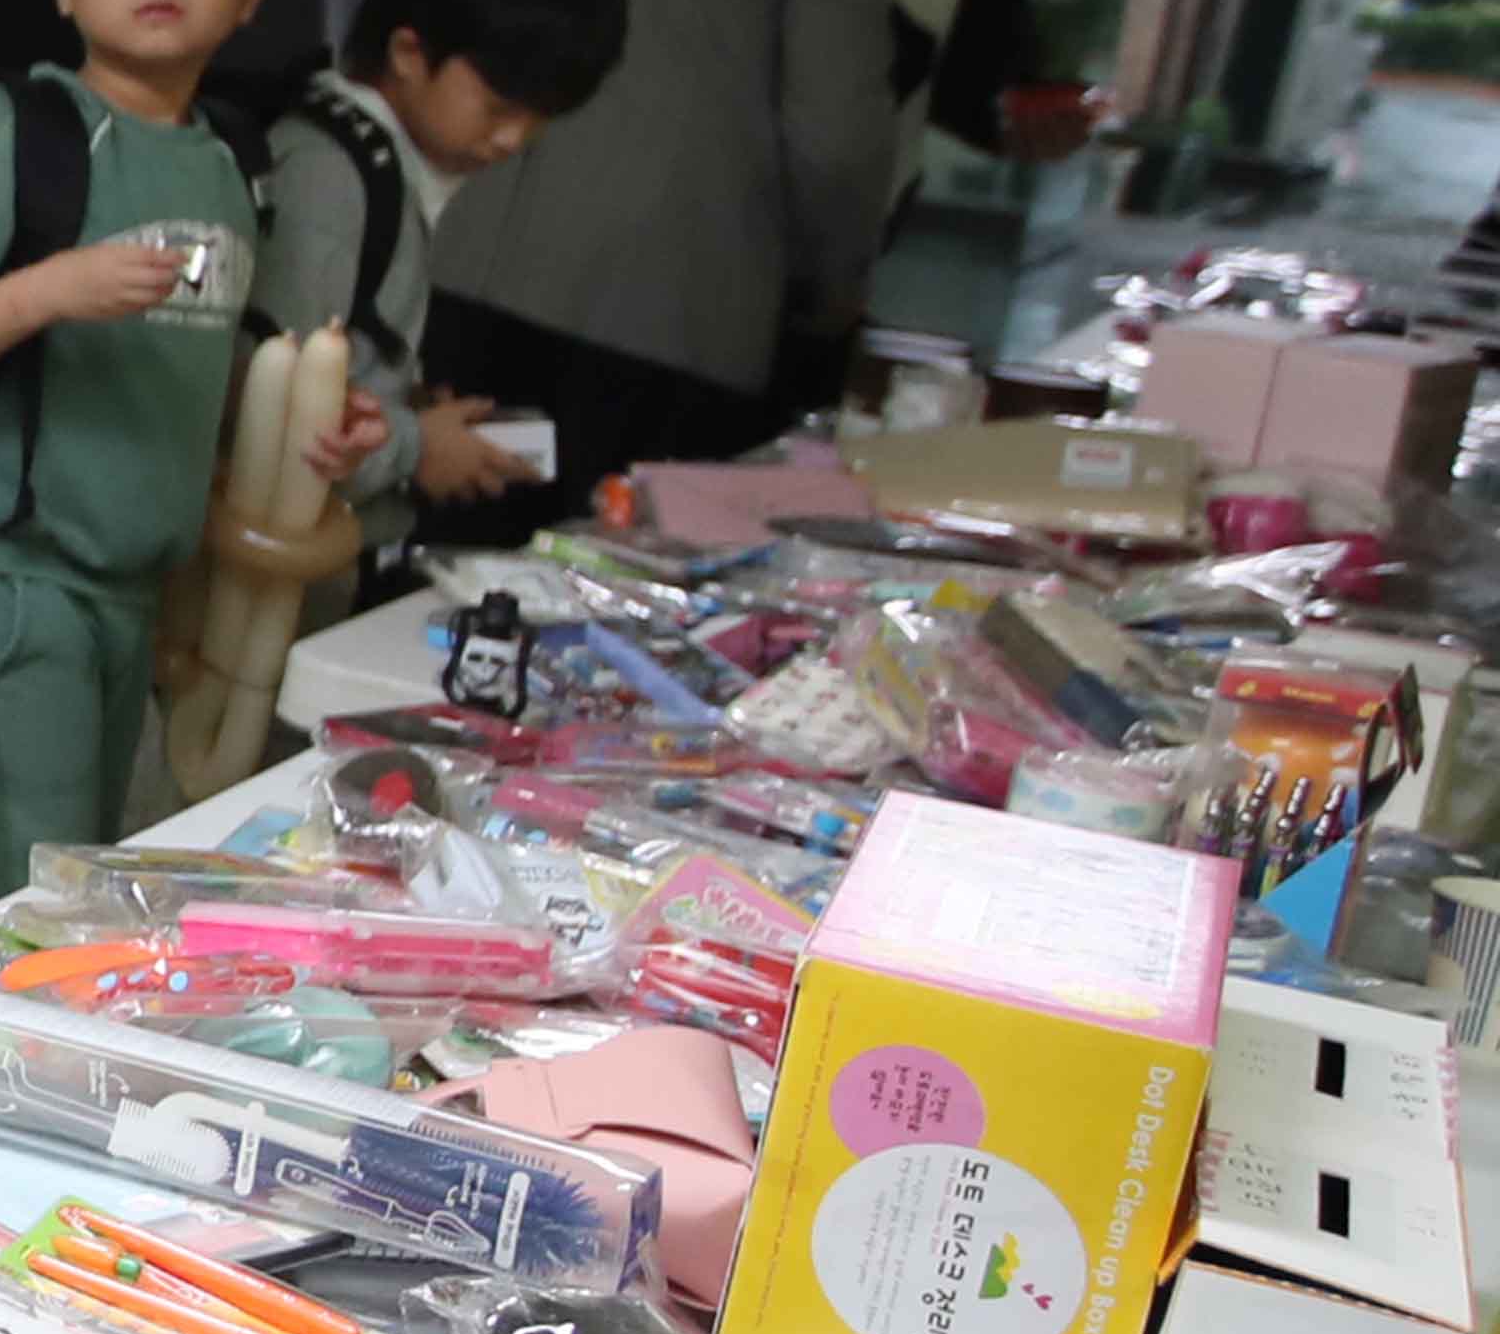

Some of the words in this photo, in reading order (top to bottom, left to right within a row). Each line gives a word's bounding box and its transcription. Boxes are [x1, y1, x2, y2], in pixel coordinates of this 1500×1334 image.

[1141, 1064, 1177, 1110] Dot
[1126, 1114, 1165, 1171] Desk
[955, 1158, 991, 1204] 도트
[1106, 1178, 1149, 1250] Clean
[936, 1213, 976, 1283] 데스크
[1093, 1254, 1125, 1288] up
